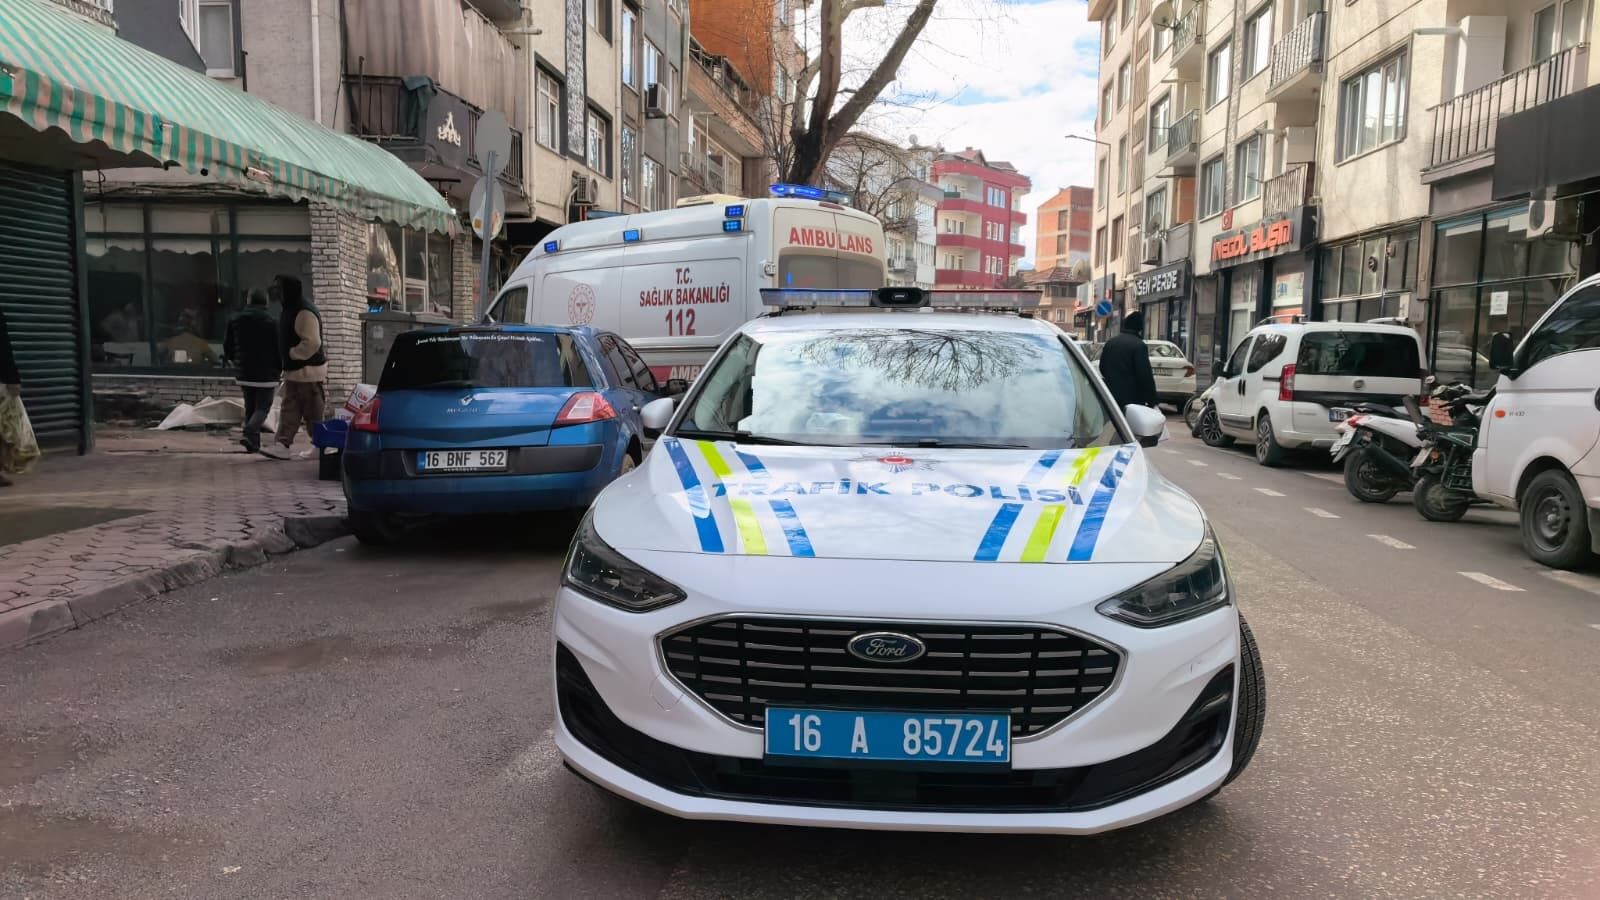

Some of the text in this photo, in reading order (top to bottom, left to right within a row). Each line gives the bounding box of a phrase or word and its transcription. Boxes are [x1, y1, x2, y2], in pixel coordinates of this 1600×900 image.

[788, 226, 873, 254] AMBULANS
[675, 267, 693, 285] T.C.
[639, 282, 730, 308] SAĞLIK BAKANLIĞI
[664, 307, 696, 337] 112
[668, 365, 705, 382] AMB
[426, 451, 505, 467] 16 BNF 562
[711, 477, 891, 498] TRAFİK
[865, 638, 907, 657] Ford
[788, 713, 1005, 757] 16 A 85724
